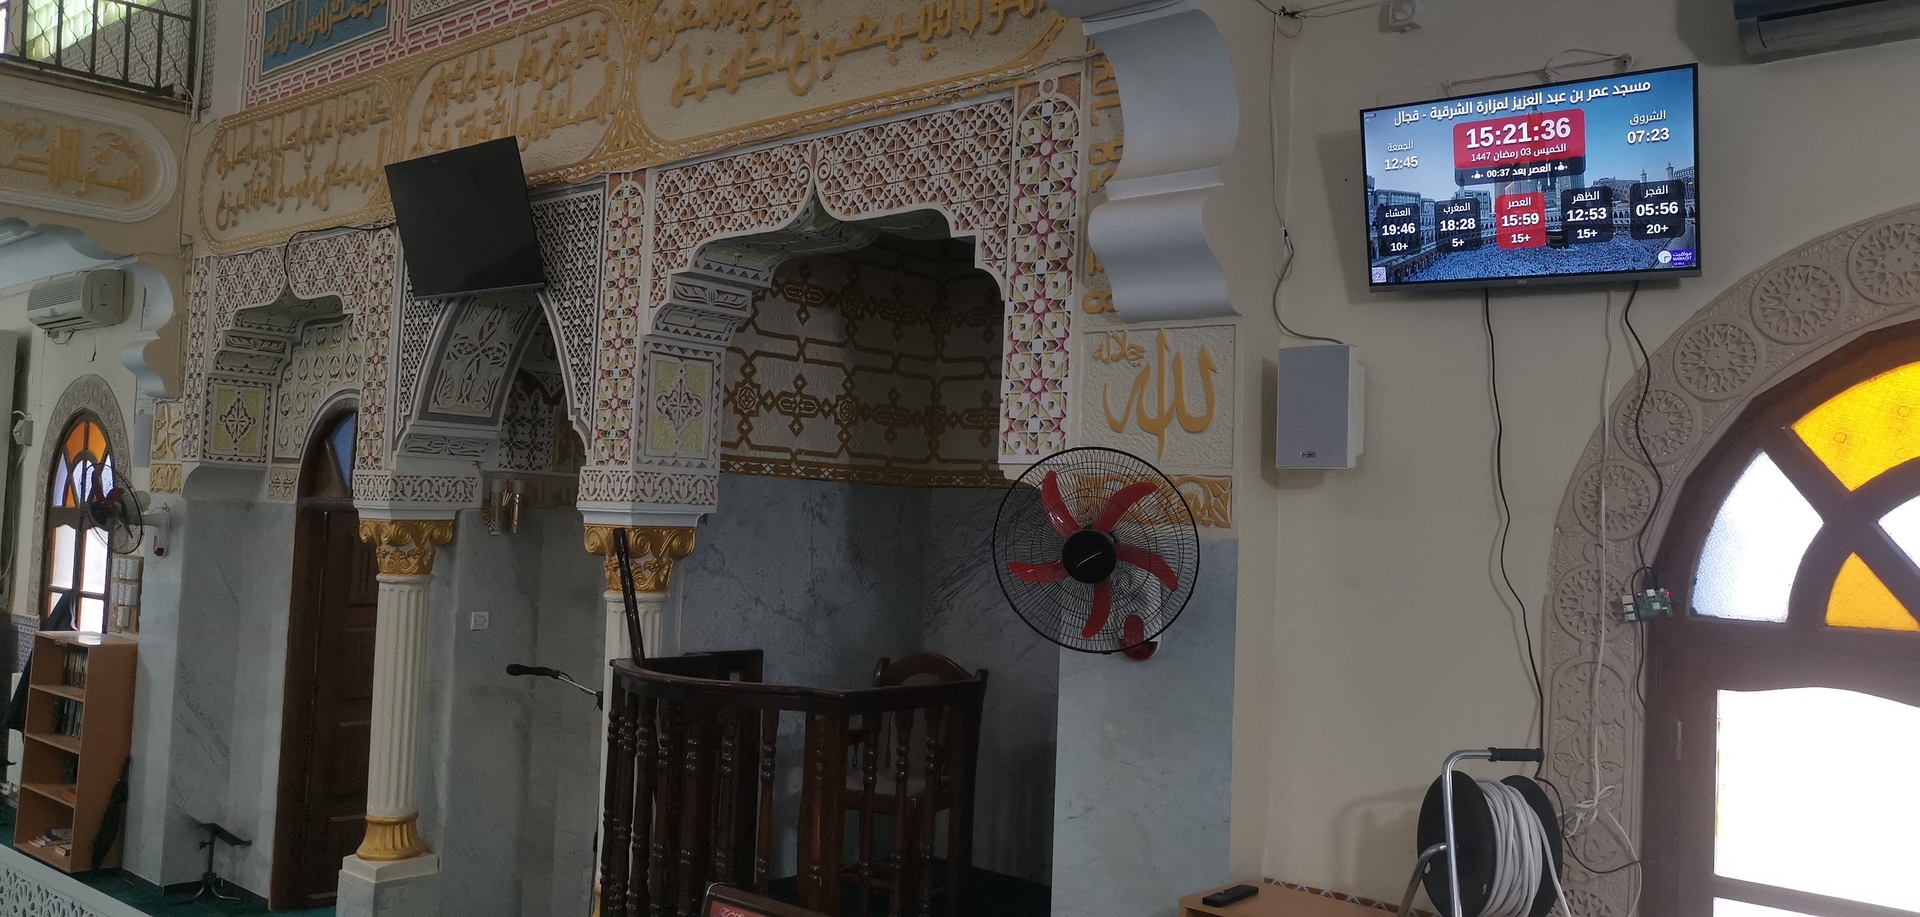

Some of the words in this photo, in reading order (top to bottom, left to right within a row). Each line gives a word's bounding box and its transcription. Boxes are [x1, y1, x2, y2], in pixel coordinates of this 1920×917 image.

[1569, 89, 1584, 103] بن
[1586, 87, 1609, 102] عمر
[1611, 81, 1651, 97] مسجد
[1476, 97, 1509, 115] لمزارة
[1511, 91, 1543, 112] العزيز
[1546, 92, 1567, 105] عبد
[1394, 109, 1420, 126] قجال
[1429, 101, 1473, 121] الشرقية
[1629, 110, 1667, 126] الشروق
[1466, 116, 1571, 149] 15:21:36
[1626, 127, 1670, 144] 07:23
[1387, 140, 1414, 152] الجمعة
[1520, 147, 1532, 156] 03
[1533, 143, 1567, 157] الخميس
[1384, 155, 1419, 170] 12:45
[1471, 152, 1492, 162] 1447
[1493, 150, 1519, 162] رمضان
[1486, 168, 1510, 178] 00:37
[1512, 166, 1527, 177] بعد
[1527, 162, 1551, 176] العصر
[1572, 190, 1600, 205] الظهر
[1644, 184, 1669, 199] الفجر
[1443, 202, 1471, 215] المغرب
[1507, 197, 1532, 210] العصر
[1636, 201, 1679, 217] 05:56
[1385, 207, 1411, 218] العشاء
[1501, 213, 1539, 227] 15:59
[1566, 207, 1607, 222] 12:53
[1382, 222, 1416, 236] 19:46
[1439, 217, 1476, 232] 18:28
[1103, 328, 1219, 461] الله
